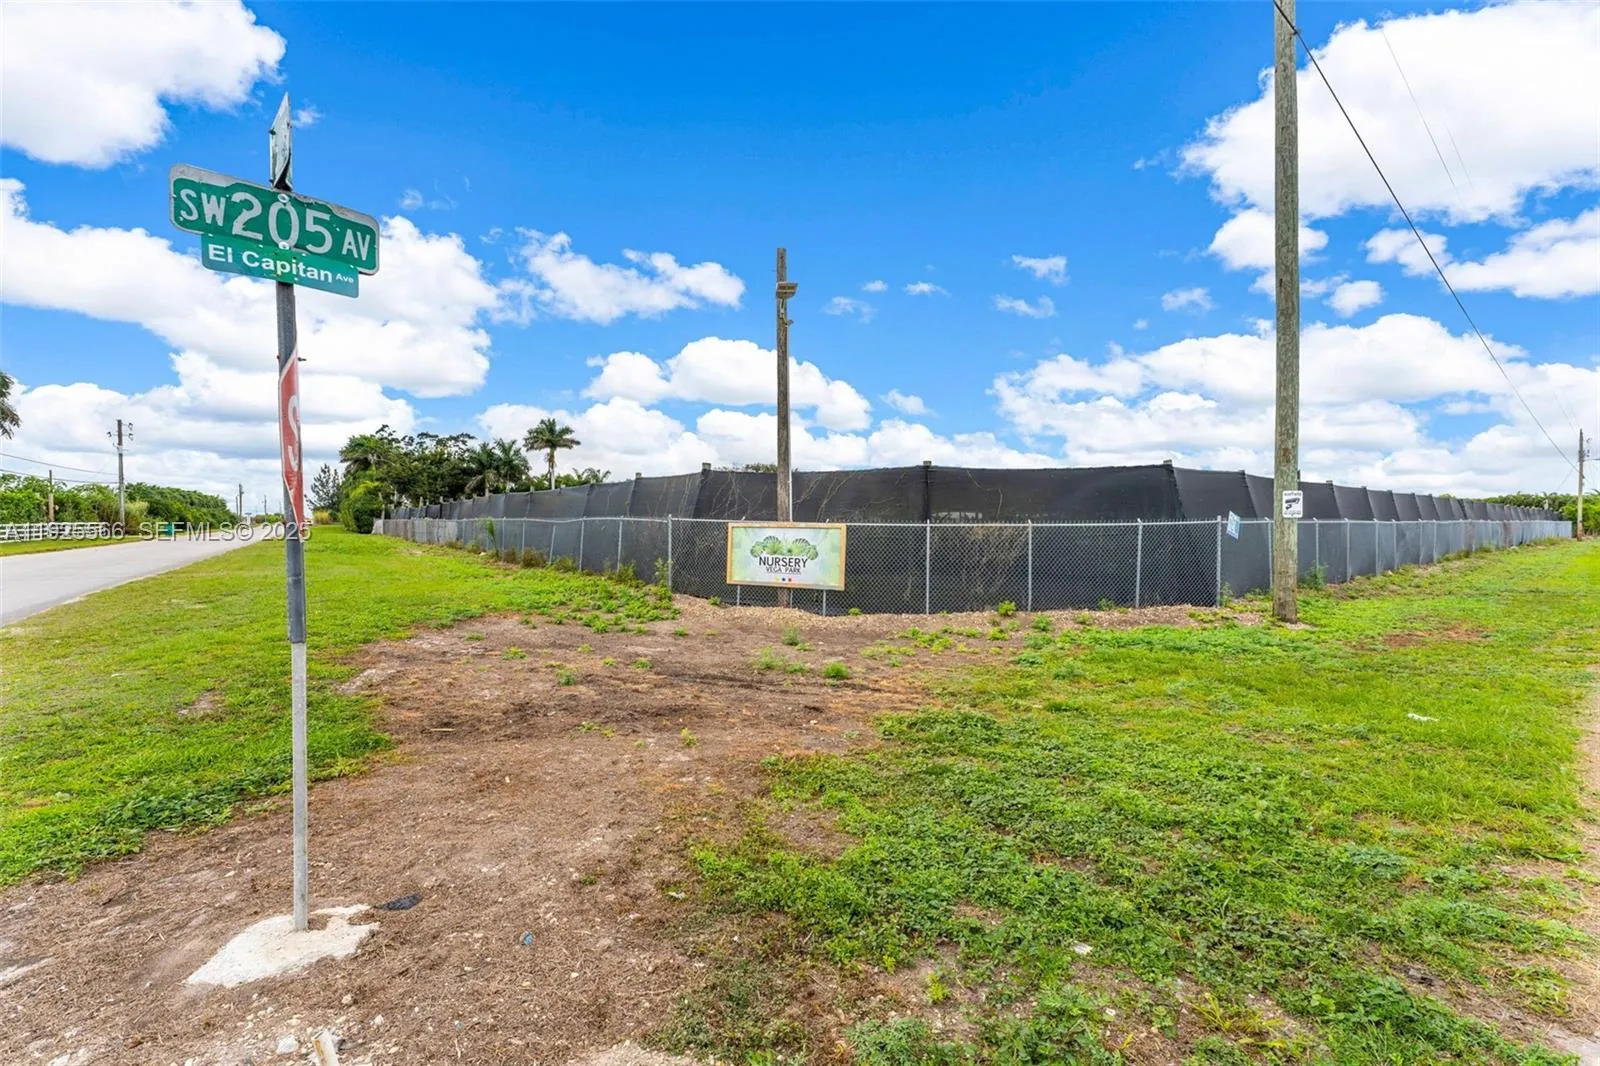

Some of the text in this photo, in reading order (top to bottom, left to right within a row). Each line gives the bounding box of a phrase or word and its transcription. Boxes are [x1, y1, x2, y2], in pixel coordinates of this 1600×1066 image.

[179, 188, 371, 261] SW 205 AV
[207, 243, 355, 284] El Capitan Ave
[758, 556, 808, 568] NURSERY
